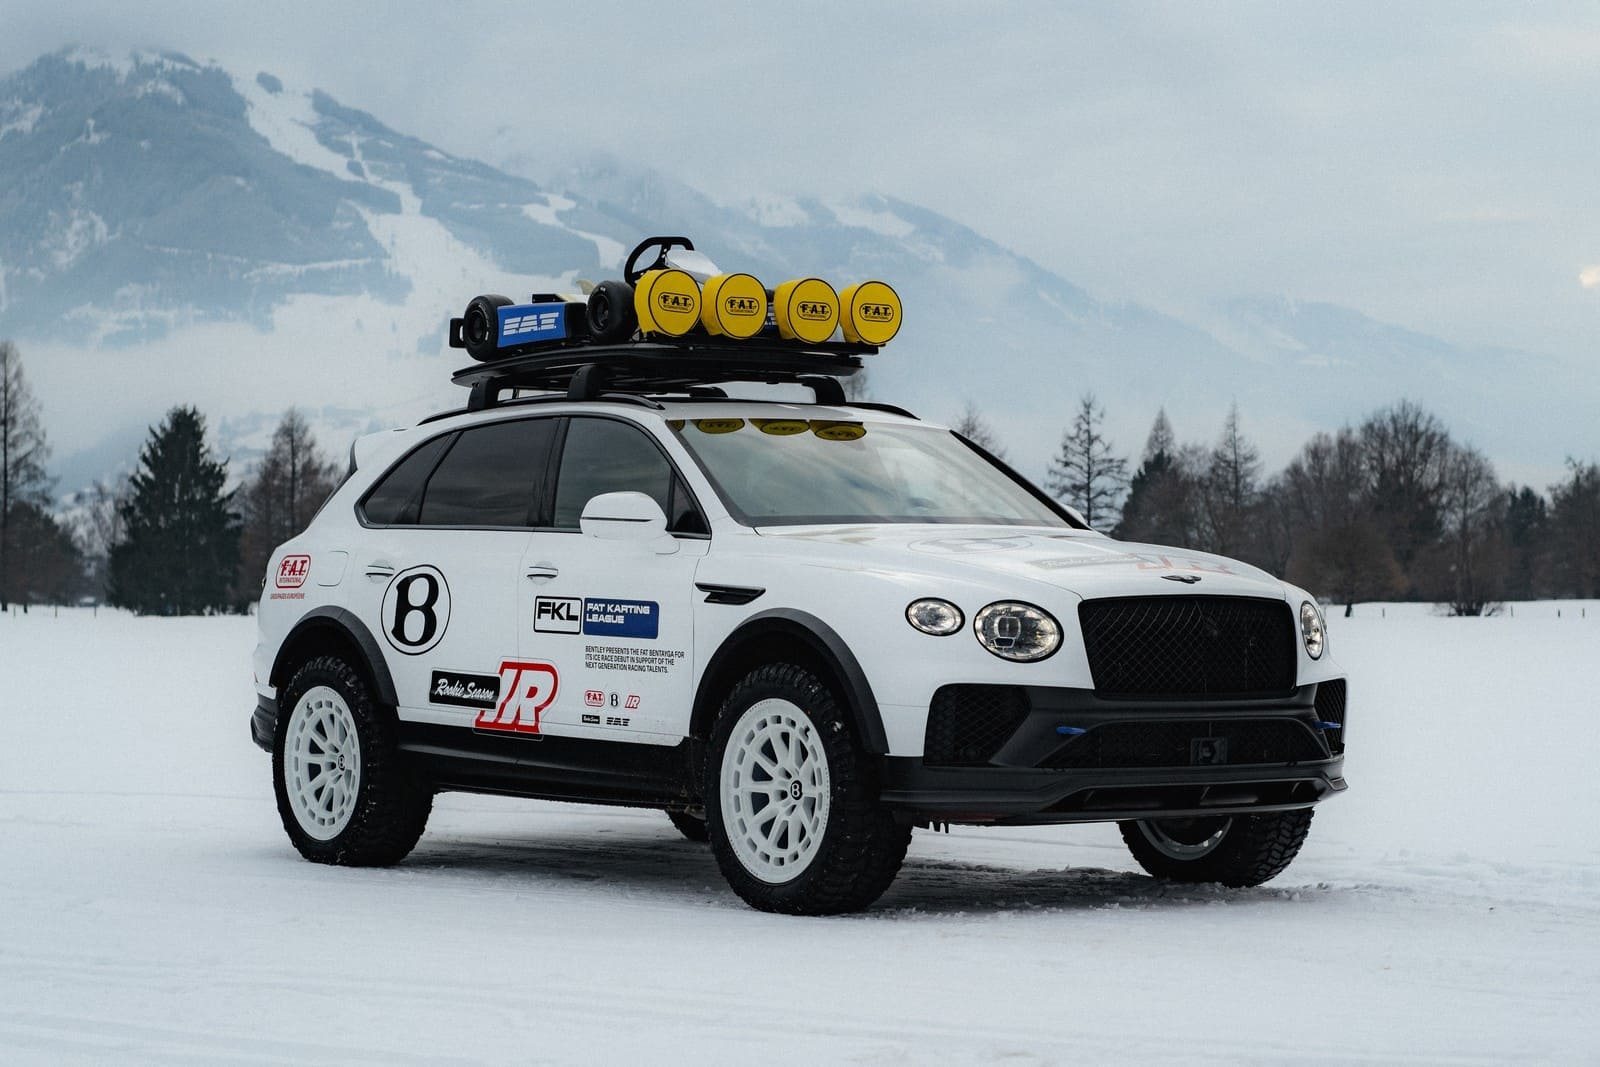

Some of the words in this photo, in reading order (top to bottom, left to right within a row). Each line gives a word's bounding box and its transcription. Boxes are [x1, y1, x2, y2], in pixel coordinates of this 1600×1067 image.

[537, 601, 579, 621] FKL
[586, 603, 605, 612] FAT
[607, 604, 650, 615] KARTING
[586, 614, 625, 624] LEAGUE
[585, 645, 605, 653] BENTLEY
[606, 647, 630, 655] PRESENTS
[649, 649, 675, 658] BENTAYGA
[614, 655, 629, 663] DEBUT
[598, 662, 627, 671] GENERATION
[628, 664, 646, 672] RACING
[646, 665, 669, 673] TALENTS.
[435, 678, 465, 697] Rookie
[463, 681, 495, 700] Season
